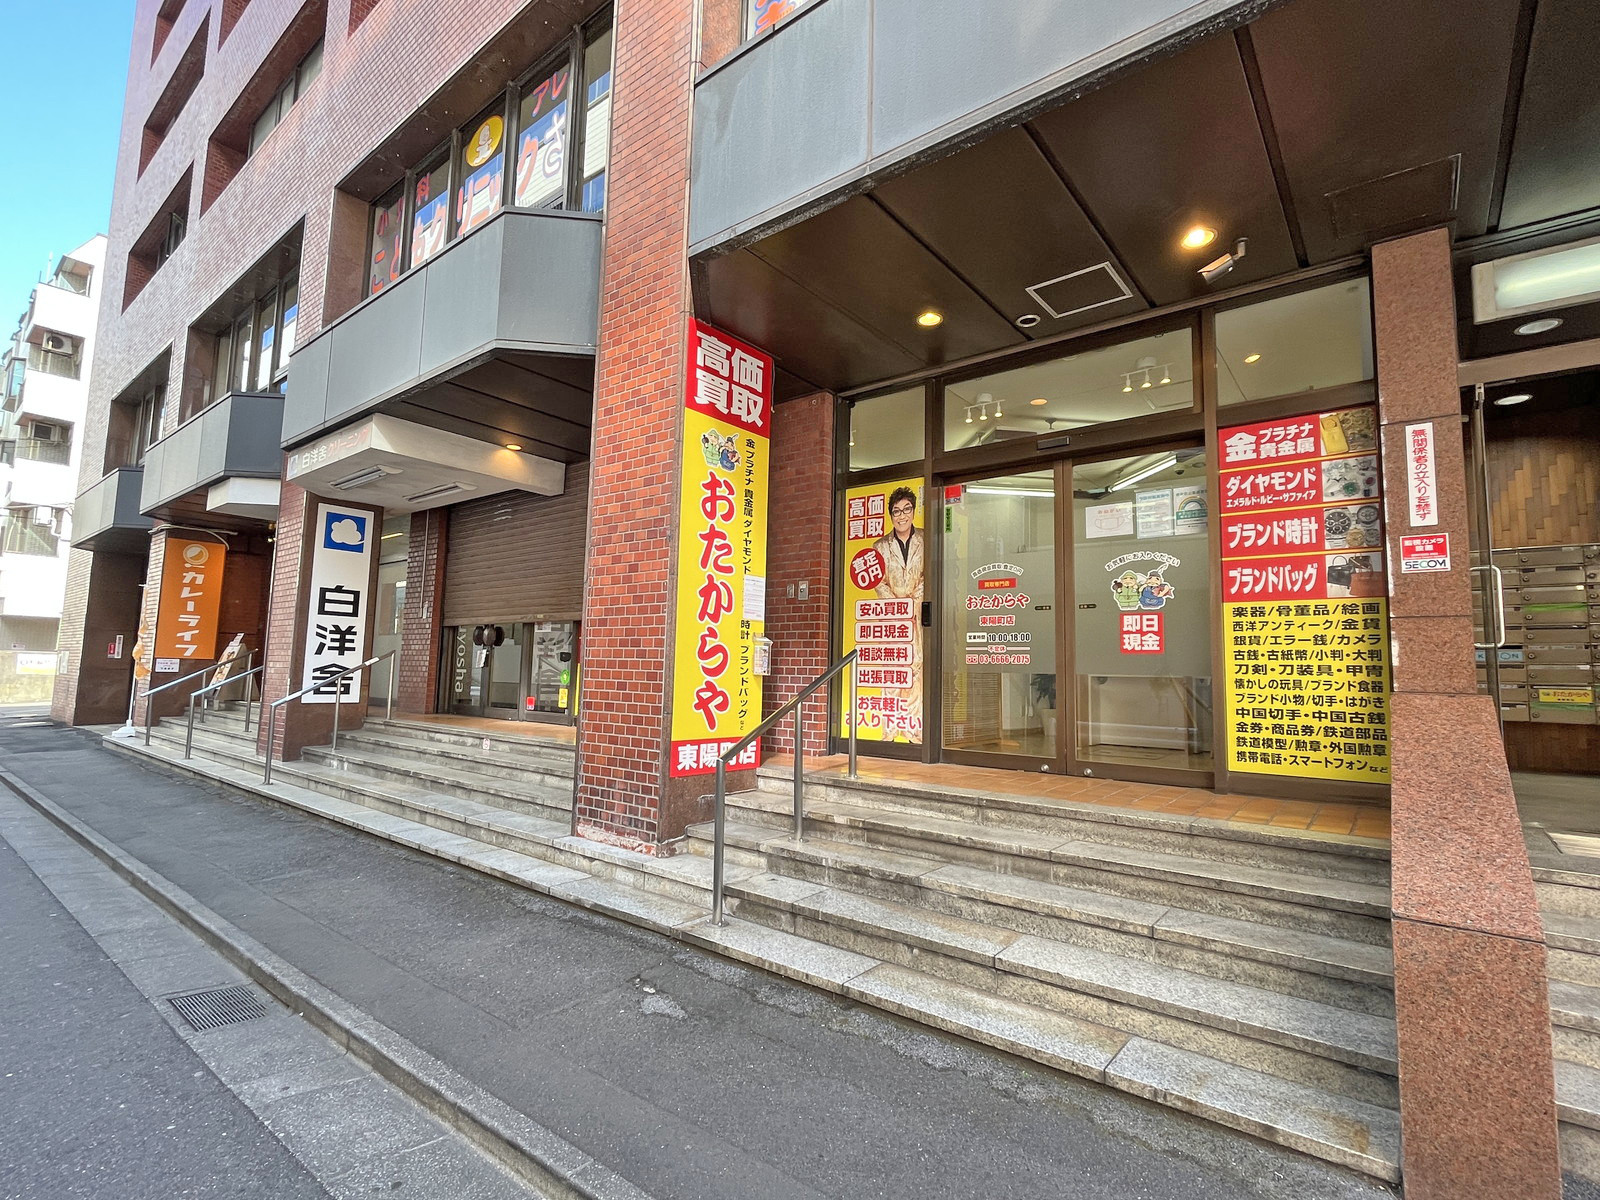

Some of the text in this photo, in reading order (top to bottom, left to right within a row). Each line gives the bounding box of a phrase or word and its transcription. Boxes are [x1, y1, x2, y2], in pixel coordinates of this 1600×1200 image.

[696, 330, 764, 393] 高価
[693, 368, 763, 428] 買取
[745, 438, 755, 451] 金
[1225, 422, 1314, 463] 金 プラチナ
[1259, 437, 1315, 459] 貴金属
[744, 450, 755, 486] プラチナ
[1226, 467, 1317, 497] ダイヤモンド
[743, 489, 754, 518] 貴金属
[849, 495, 884, 518] 高価
[849, 517, 884, 539] 買取
[1227, 516, 1318, 548] ブランド時計
[742, 519, 753, 574] ダイヤモンド
[852, 550, 878, 574] 査定
[1405, 559, 1446, 570] SECOM
[1228, 562, 1318, 595] ブランドバッグ
[693, 470, 735, 732] おたからや
[860, 602, 909, 617] 安心買取
[966, 593, 1030, 609] おたからや
[175, 571, 205, 657] カレーライフ
[980, 615, 1014, 625] 東陽町店
[1123, 615, 1159, 632] 即日
[740, 619, 750, 640] 時計
[860, 624, 909, 639] 即日現金
[1123, 633, 1160, 651] 現金
[859, 647, 908, 662] 相談無料
[859, 669, 908, 685] 出張買取
[858, 696, 908, 713] お気軽に
[1235, 707, 1386, 725] 中国切手・中国古銭
